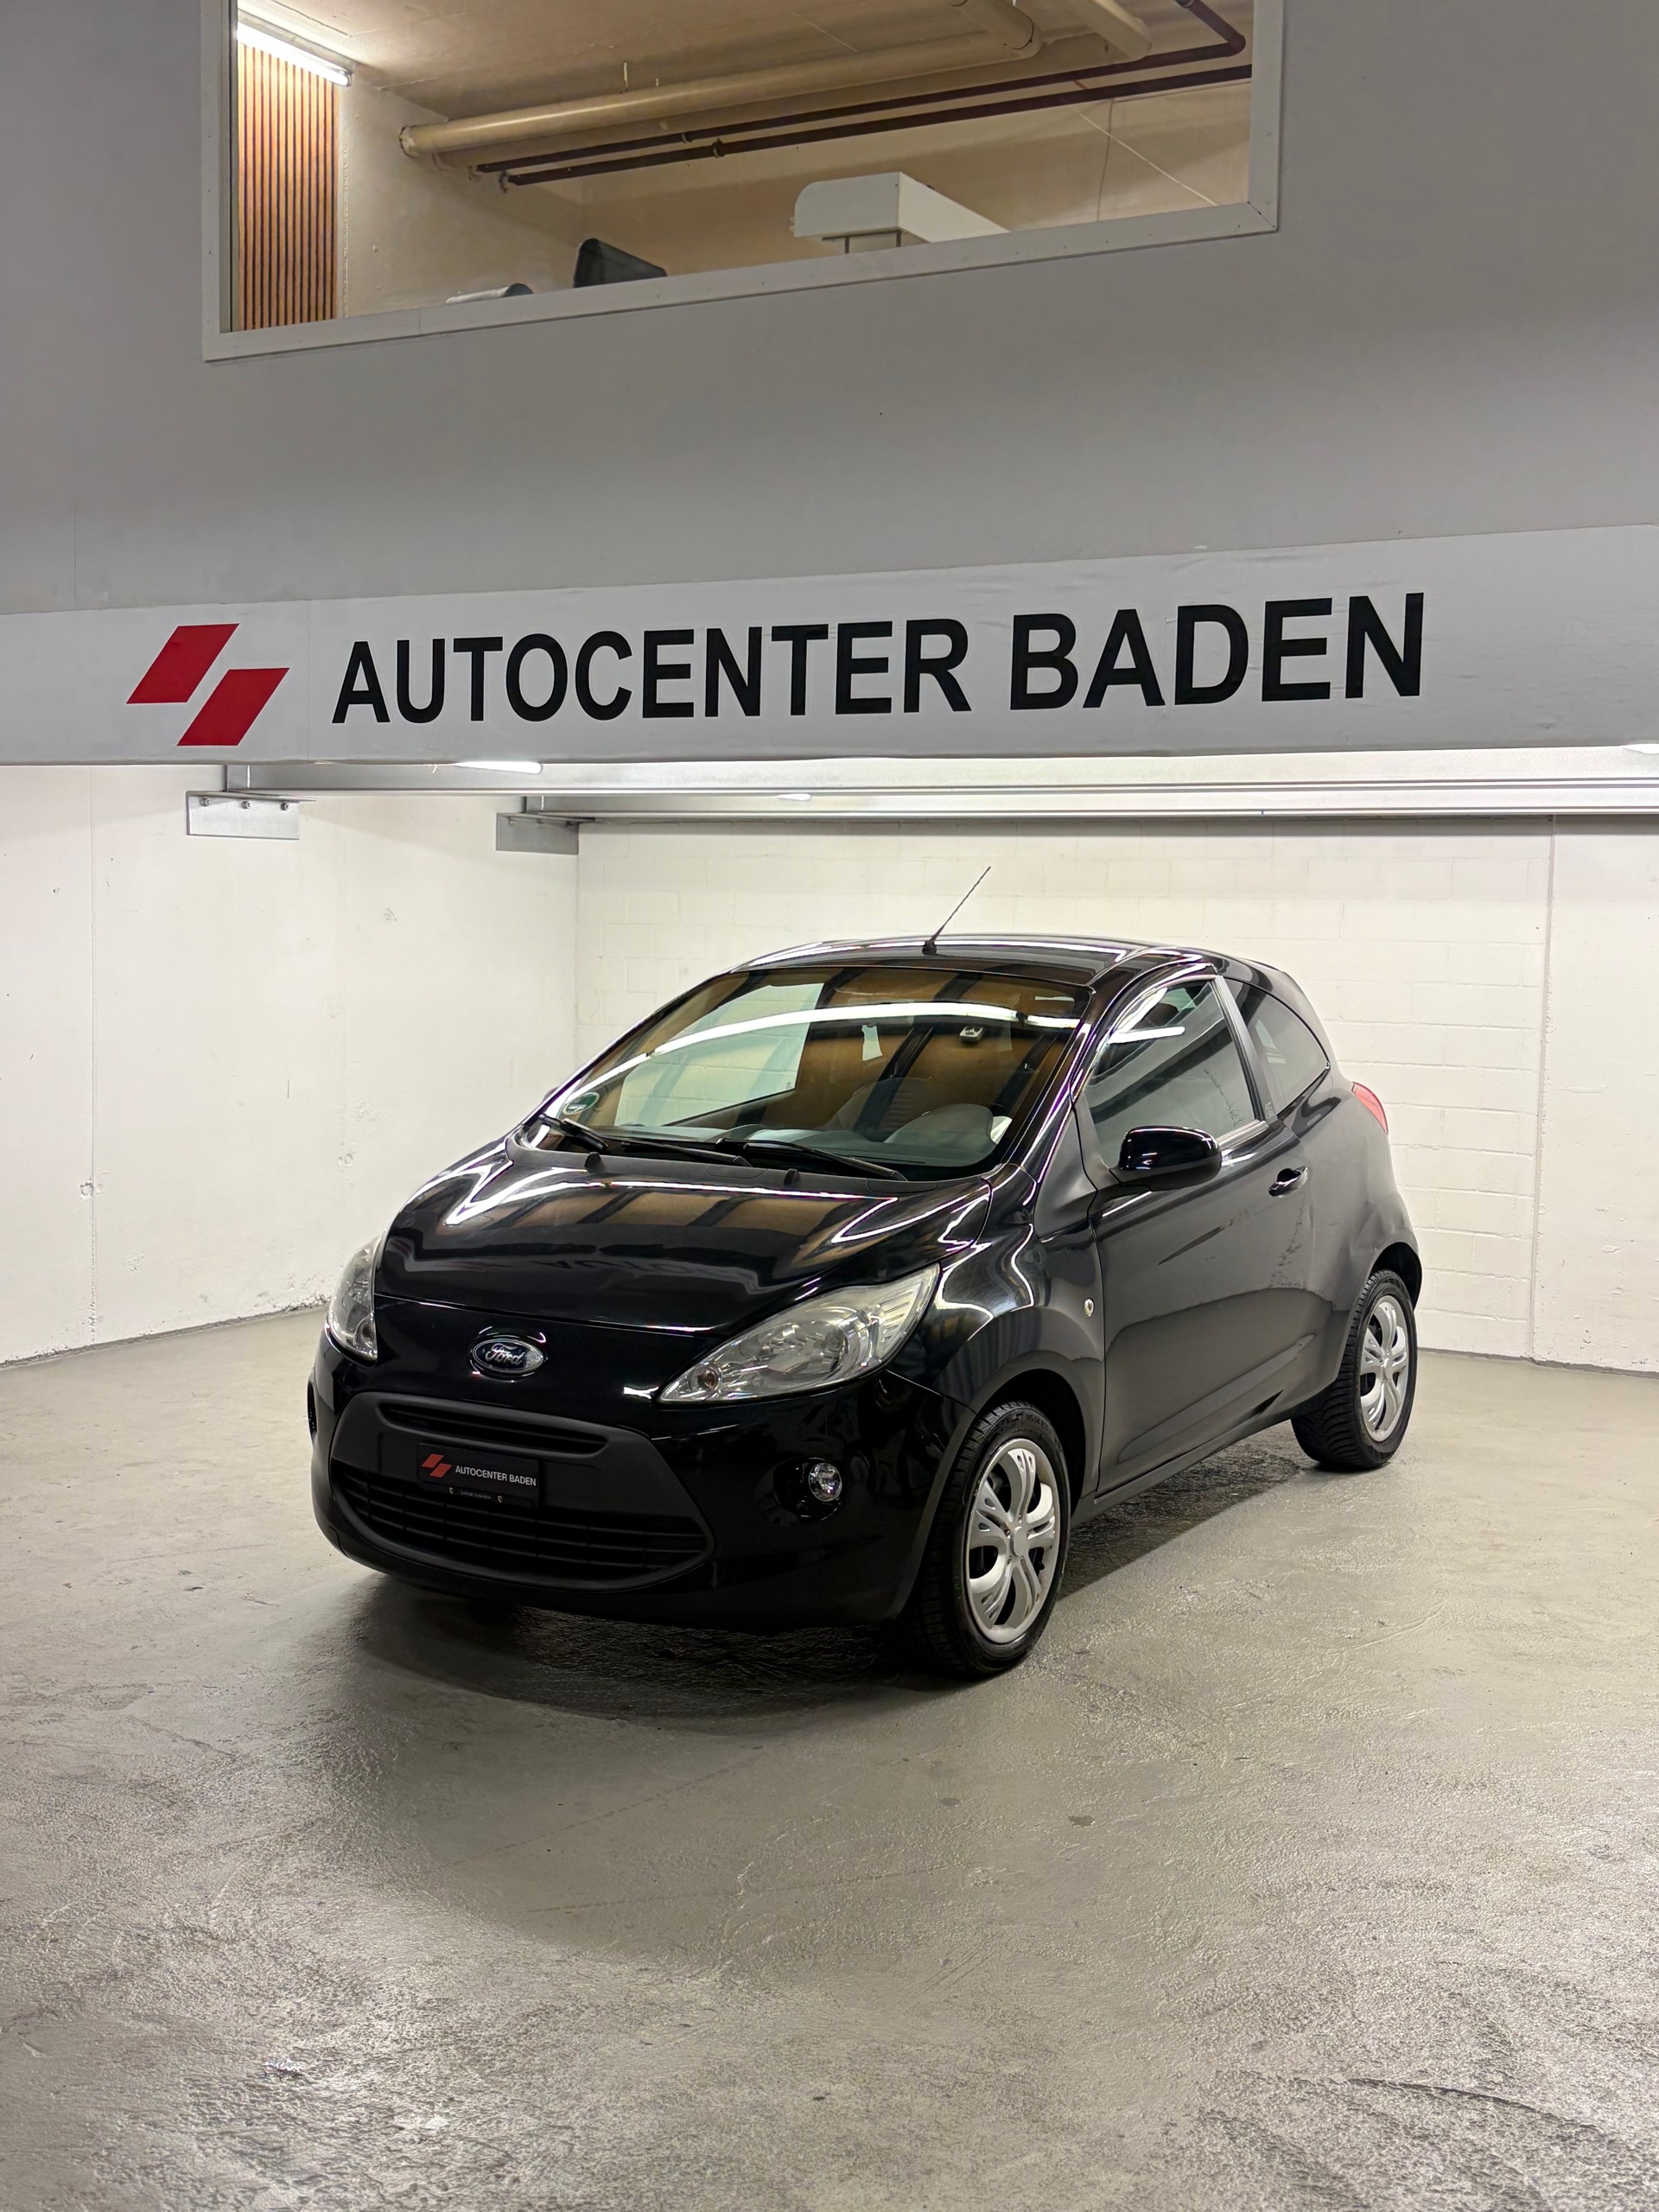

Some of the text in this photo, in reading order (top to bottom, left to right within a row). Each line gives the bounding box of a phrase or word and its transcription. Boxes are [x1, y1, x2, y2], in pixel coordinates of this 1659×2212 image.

[332, 593, 1424, 724] AUTOCENTER BADEN
[486, 1343, 525, 1365] Ford
[455, 1465, 537, 1486] AUTOCENTER BADEN
